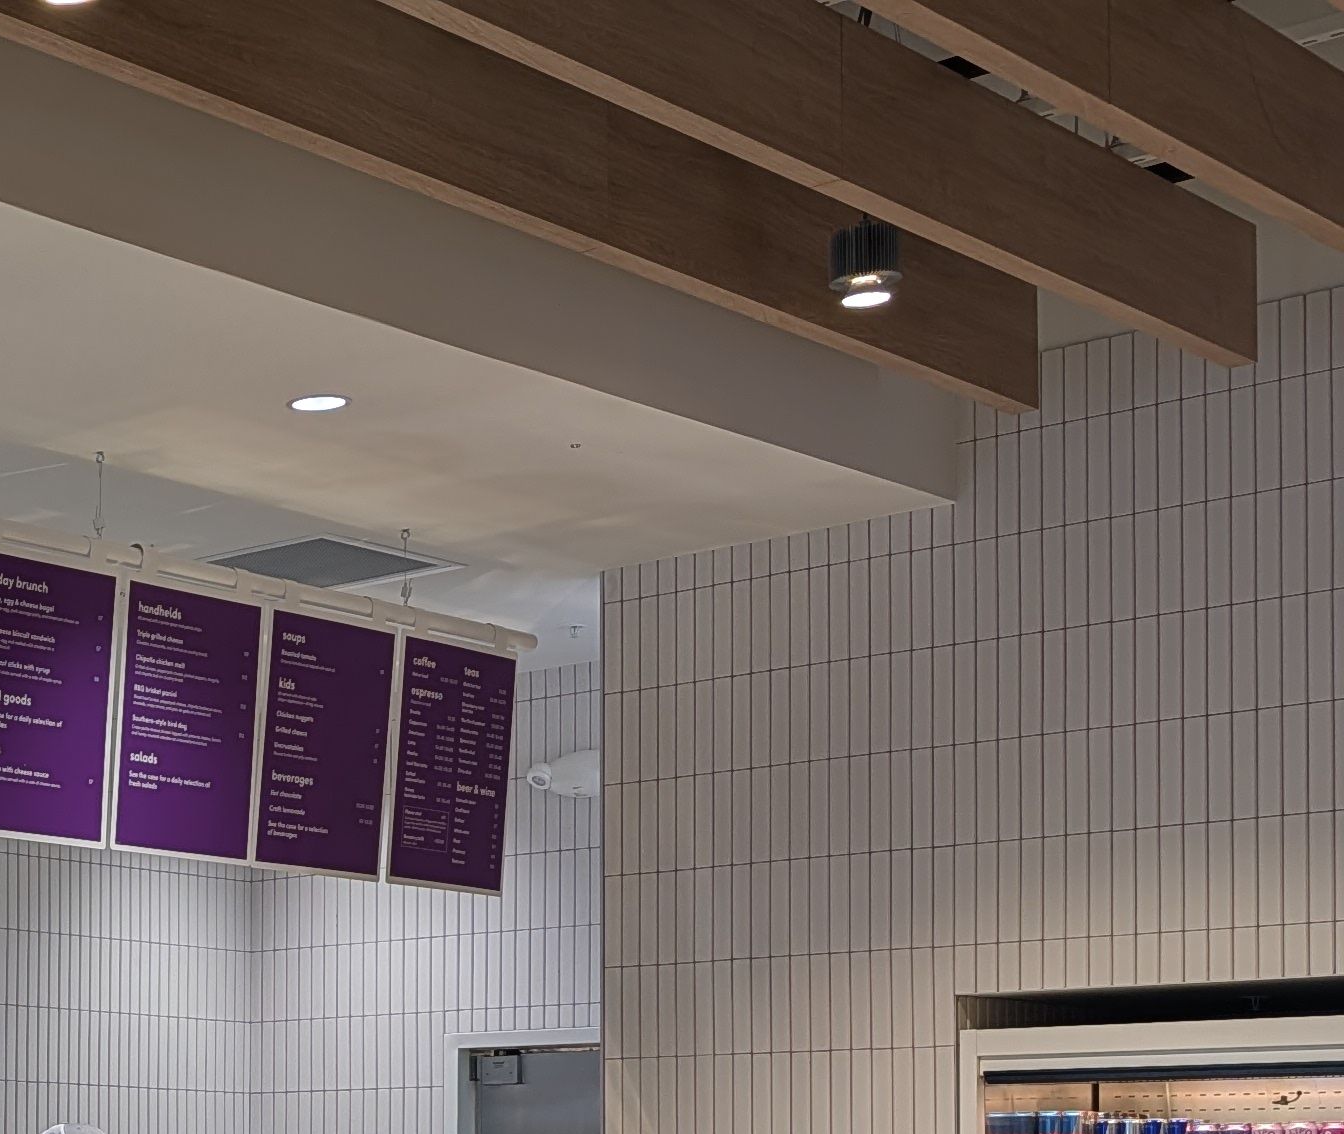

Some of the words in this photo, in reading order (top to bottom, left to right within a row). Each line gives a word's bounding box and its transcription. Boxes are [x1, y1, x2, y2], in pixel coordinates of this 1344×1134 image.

[15, 575, 49, 594] brunch
[4, 598, 14, 607] egg
[20, 598, 38, 610] cheese
[39, 601, 55, 613] bagel
[138, 600, 182, 620] handhelds
[12, 628, 30, 639] biscuit
[30, 632, 56, 644] sandwich
[137, 628, 150, 638] Triple
[150, 632, 166, 642] grilled
[167, 635, 184, 645] cheese
[282, 632, 306, 646] soups
[8, 659, 22, 670] sticks
[24, 663, 34, 672] with
[36, 665, 50, 676] syrup
[135, 654, 156, 664] Chipotle
[156, 657, 174, 668] chicken
[413, 656, 436, 669] coffee
[464, 666, 480, 678] teas
[134, 683, 144, 693] BBQ
[145, 686, 162, 696] brisket
[278, 676, 296, 690] kids
[3, 694, 32, 706] goods
[411, 687, 444, 700] espresso
[5, 712, 13, 720] for
[18, 714, 32, 725] daily
[32, 717, 56, 727] selection
[276, 710, 294, 719] Chicken
[132, 714, 166, 726] Southern-style
[167, 720, 178, 728] bird
[178, 721, 188, 732] dog
[275, 725, 292, 734] Grilled
[130, 750, 158, 764] salads
[2, 766, 14, 774] with
[14, 767, 32, 777] cheese
[272, 769, 314, 788] beverages
[128, 770, 138, 778] See
[138, 771, 146, 780] the
[170, 776, 184, 786] daily
[184, 779, 204, 788] selection
[128, 779, 141, 788] fresh
[141, 782, 158, 790] salads
[456, 780, 473, 793] beer
[480, 786, 496, 798] wine
[269, 804, 282, 812] Craft
[282, 806, 306, 816] lemonade
[268, 820, 278, 828] See
[308, 826, 328, 834] selection
